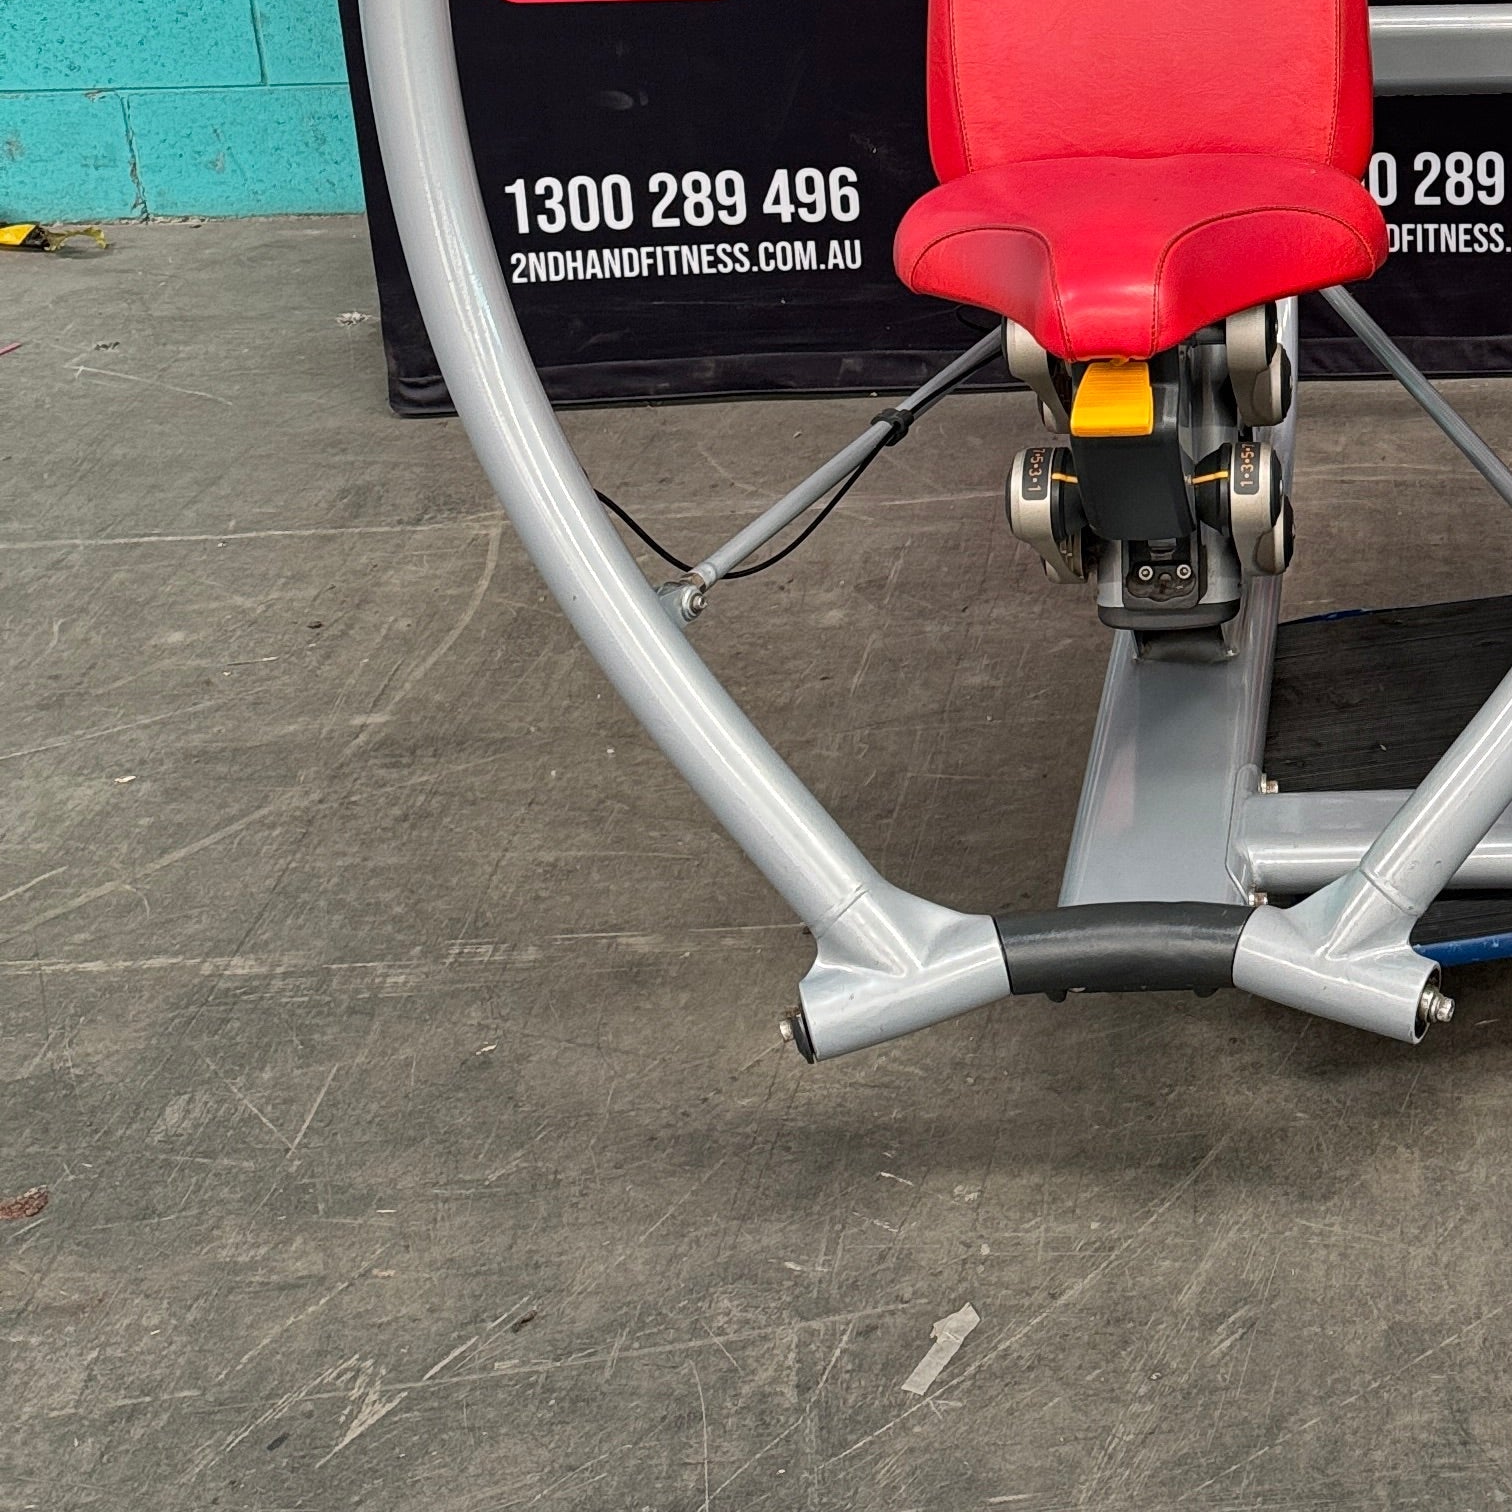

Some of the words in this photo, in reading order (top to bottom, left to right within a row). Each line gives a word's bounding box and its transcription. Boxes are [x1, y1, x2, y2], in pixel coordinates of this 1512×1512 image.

[504, 173, 634, 234] 1300
[648, 169, 747, 228] 289
[762, 166, 860, 223] 496
[1413, 151, 1505, 206] 289
[510, 239, 862, 284] 2NDHANDFITNESS.COM.AU
